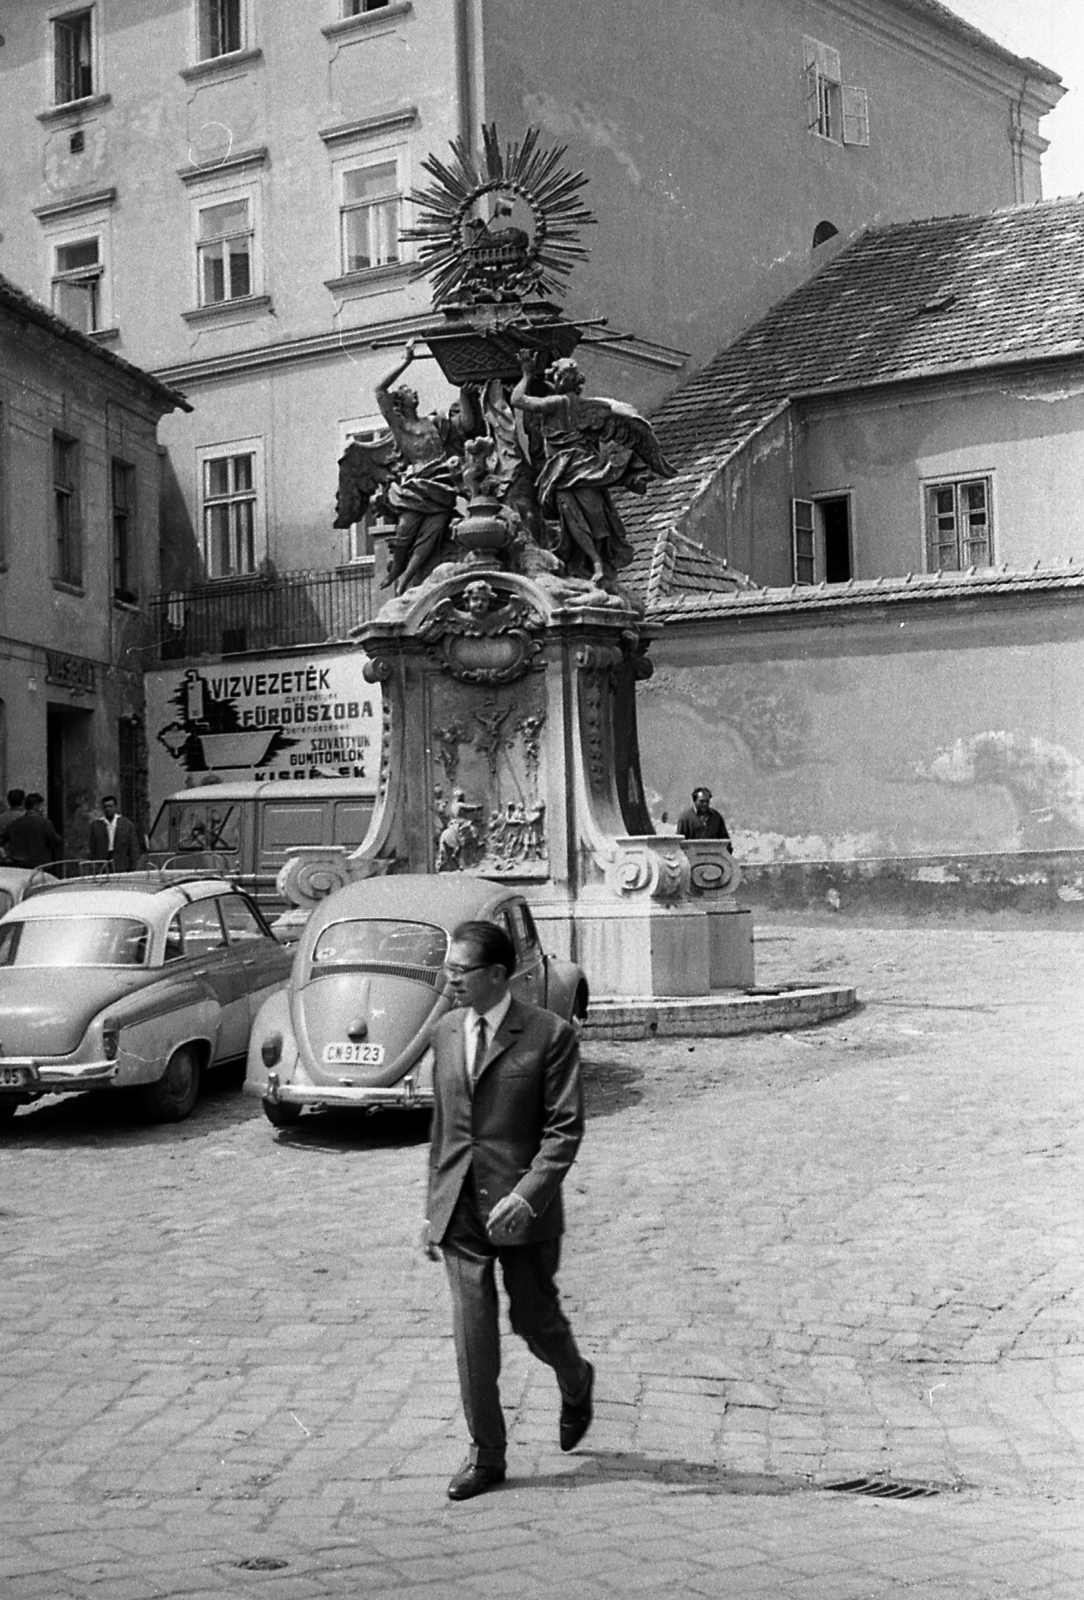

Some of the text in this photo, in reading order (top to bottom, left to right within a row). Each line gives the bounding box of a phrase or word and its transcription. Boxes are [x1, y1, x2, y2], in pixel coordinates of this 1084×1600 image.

[211, 665, 331, 699] VIZVEZETÉK
[255, 765, 366, 781] KISGÉEK
[0, 1068, 19, 1084] 05
